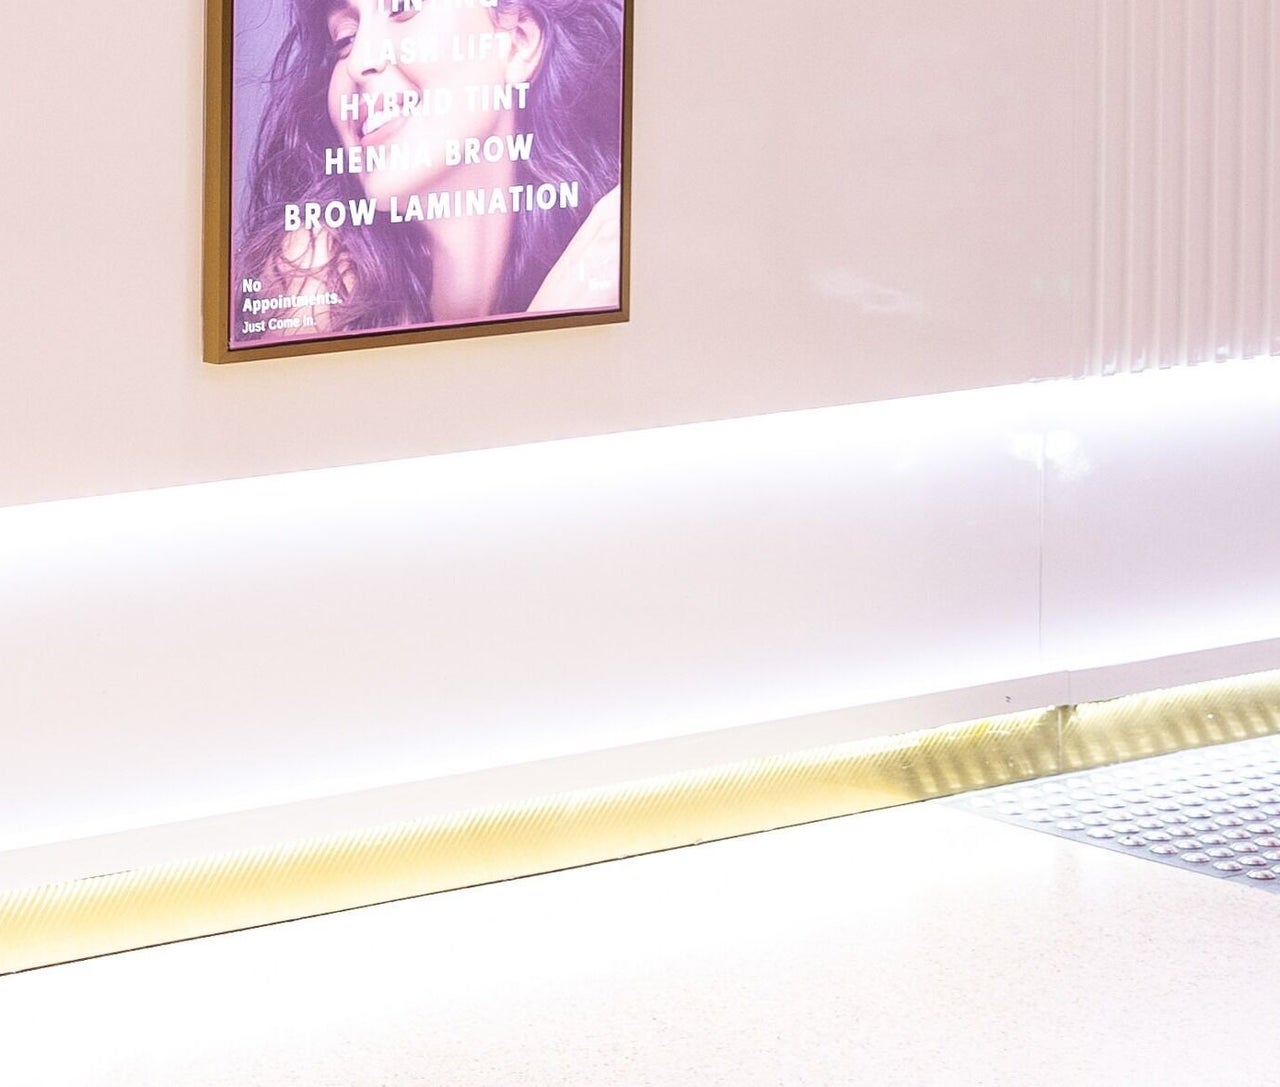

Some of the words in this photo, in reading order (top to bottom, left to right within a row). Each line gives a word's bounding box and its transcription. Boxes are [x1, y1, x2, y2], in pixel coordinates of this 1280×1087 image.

[364, 35, 439, 65] LASH
[452, 32, 511, 61] LIFT
[340, 87, 453, 121] HYBRID
[464, 82, 530, 114] TINT
[325, 140, 433, 175] HENNA
[445, 133, 534, 166] BROW
[284, 199, 377, 231] BROW
[390, 181, 579, 223] LAMINATION
[242, 278, 262, 293] No
[242, 292, 343, 314] Appointments.
[242, 320, 265, 334] Just
[268, 317, 300, 330] Come
